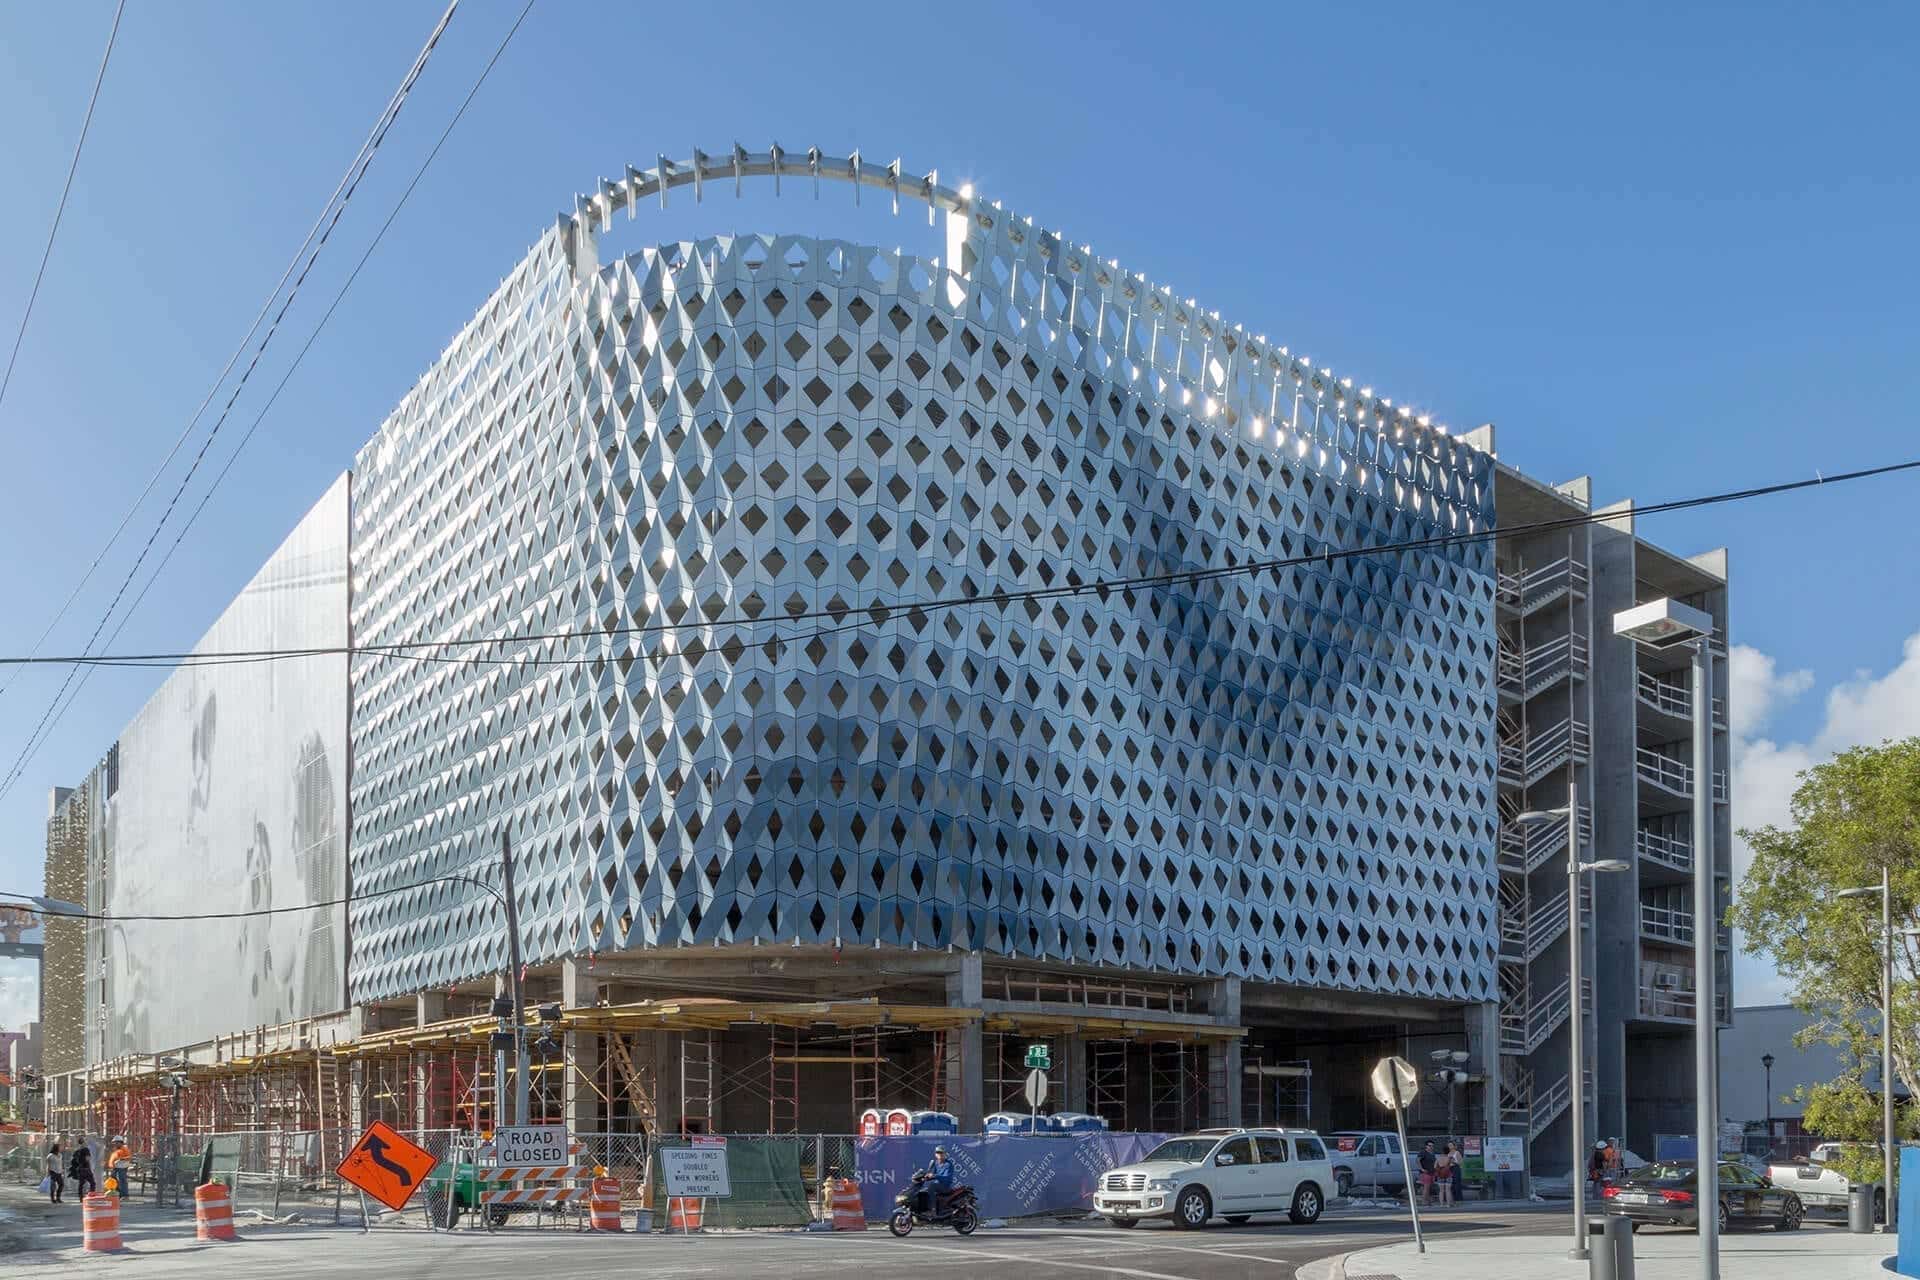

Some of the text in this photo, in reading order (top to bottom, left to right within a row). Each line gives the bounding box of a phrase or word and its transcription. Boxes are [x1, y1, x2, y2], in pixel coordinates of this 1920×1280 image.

[511, 1131, 553, 1145] ROAD
[503, 1148, 562, 1162] CLOSED
[671, 1152, 718, 1160] SPEEDING FINES
[951, 1143, 983, 1176] WHERE
[1080, 1143, 1106, 1172] FASHIO
[683, 1163, 708, 1171] DOUBLED
[675, 1174, 720, 1182] WHEN WORKERS
[854, 1168, 896, 1185] SIGN
[1007, 1160, 1034, 1191] WHERE
[1015, 1151, 1055, 1200] CREATIVITY
[686, 1185, 711, 1193] PRESENT
[1023, 1169, 1056, 1209] HAPPENS
